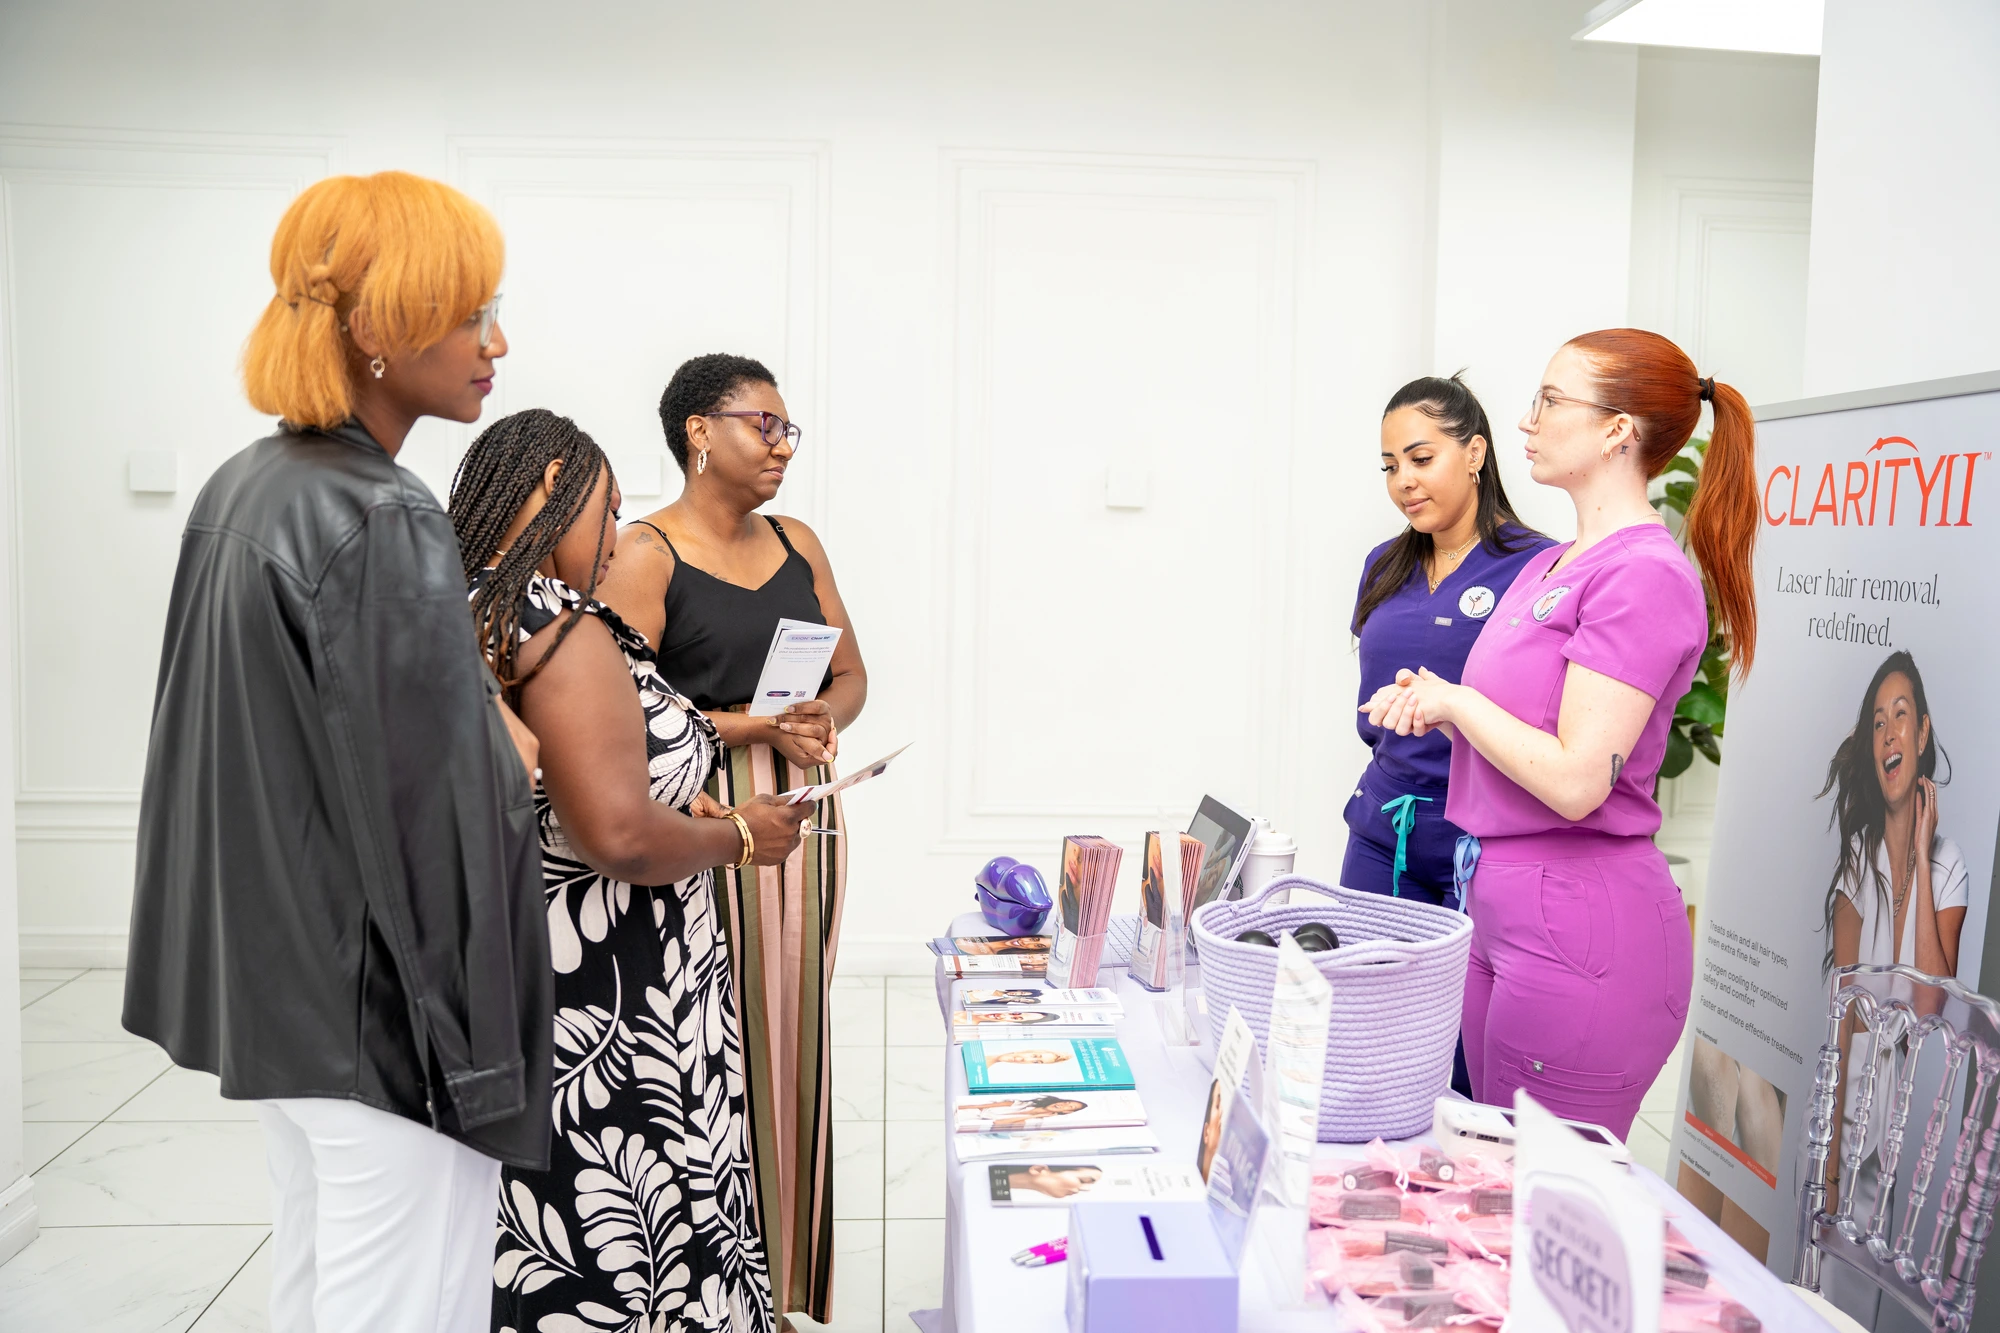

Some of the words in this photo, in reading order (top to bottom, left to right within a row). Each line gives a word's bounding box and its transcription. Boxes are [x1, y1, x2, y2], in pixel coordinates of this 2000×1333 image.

[1777, 566, 1822, 595] Laser
[1825, 568, 1858, 598] hair
[1862, 573, 1941, 610] removal,
[1808, 611, 1893, 648] redefined.
[1708, 936, 1720, 948] even
[1720, 943, 1736, 956] extra
[1736, 948, 1748, 962] fine
[1749, 954, 1761, 968] hair
[1709, 920, 1726, 937] Treats
[1726, 928, 1738, 941] skin
[1739, 936, 1750, 948] and
[1751, 941, 1759, 951] all
[1759, 944, 1771, 957] hair
[1771, 951, 1789, 969] types,
[1703, 972, 1719, 990] safety
[1720, 981, 1731, 994] and
[1732, 989, 1756, 1008] comfort
[1704, 957, 1727, 979] Cryogen
[1728, 973, 1750, 991] cooling
[1750, 980, 1759, 994] for
[1759, 989, 1788, 1011] optimized
[1700, 995, 1717, 1012] Faster
[1717, 1006, 1728, 1019] and
[1729, 1014, 1744, 1028] more
[1745, 1022, 1771, 1044] effective
[1771, 1038, 1804, 1065] treatments
[1533, 1229, 1621, 1328] SECRET!
